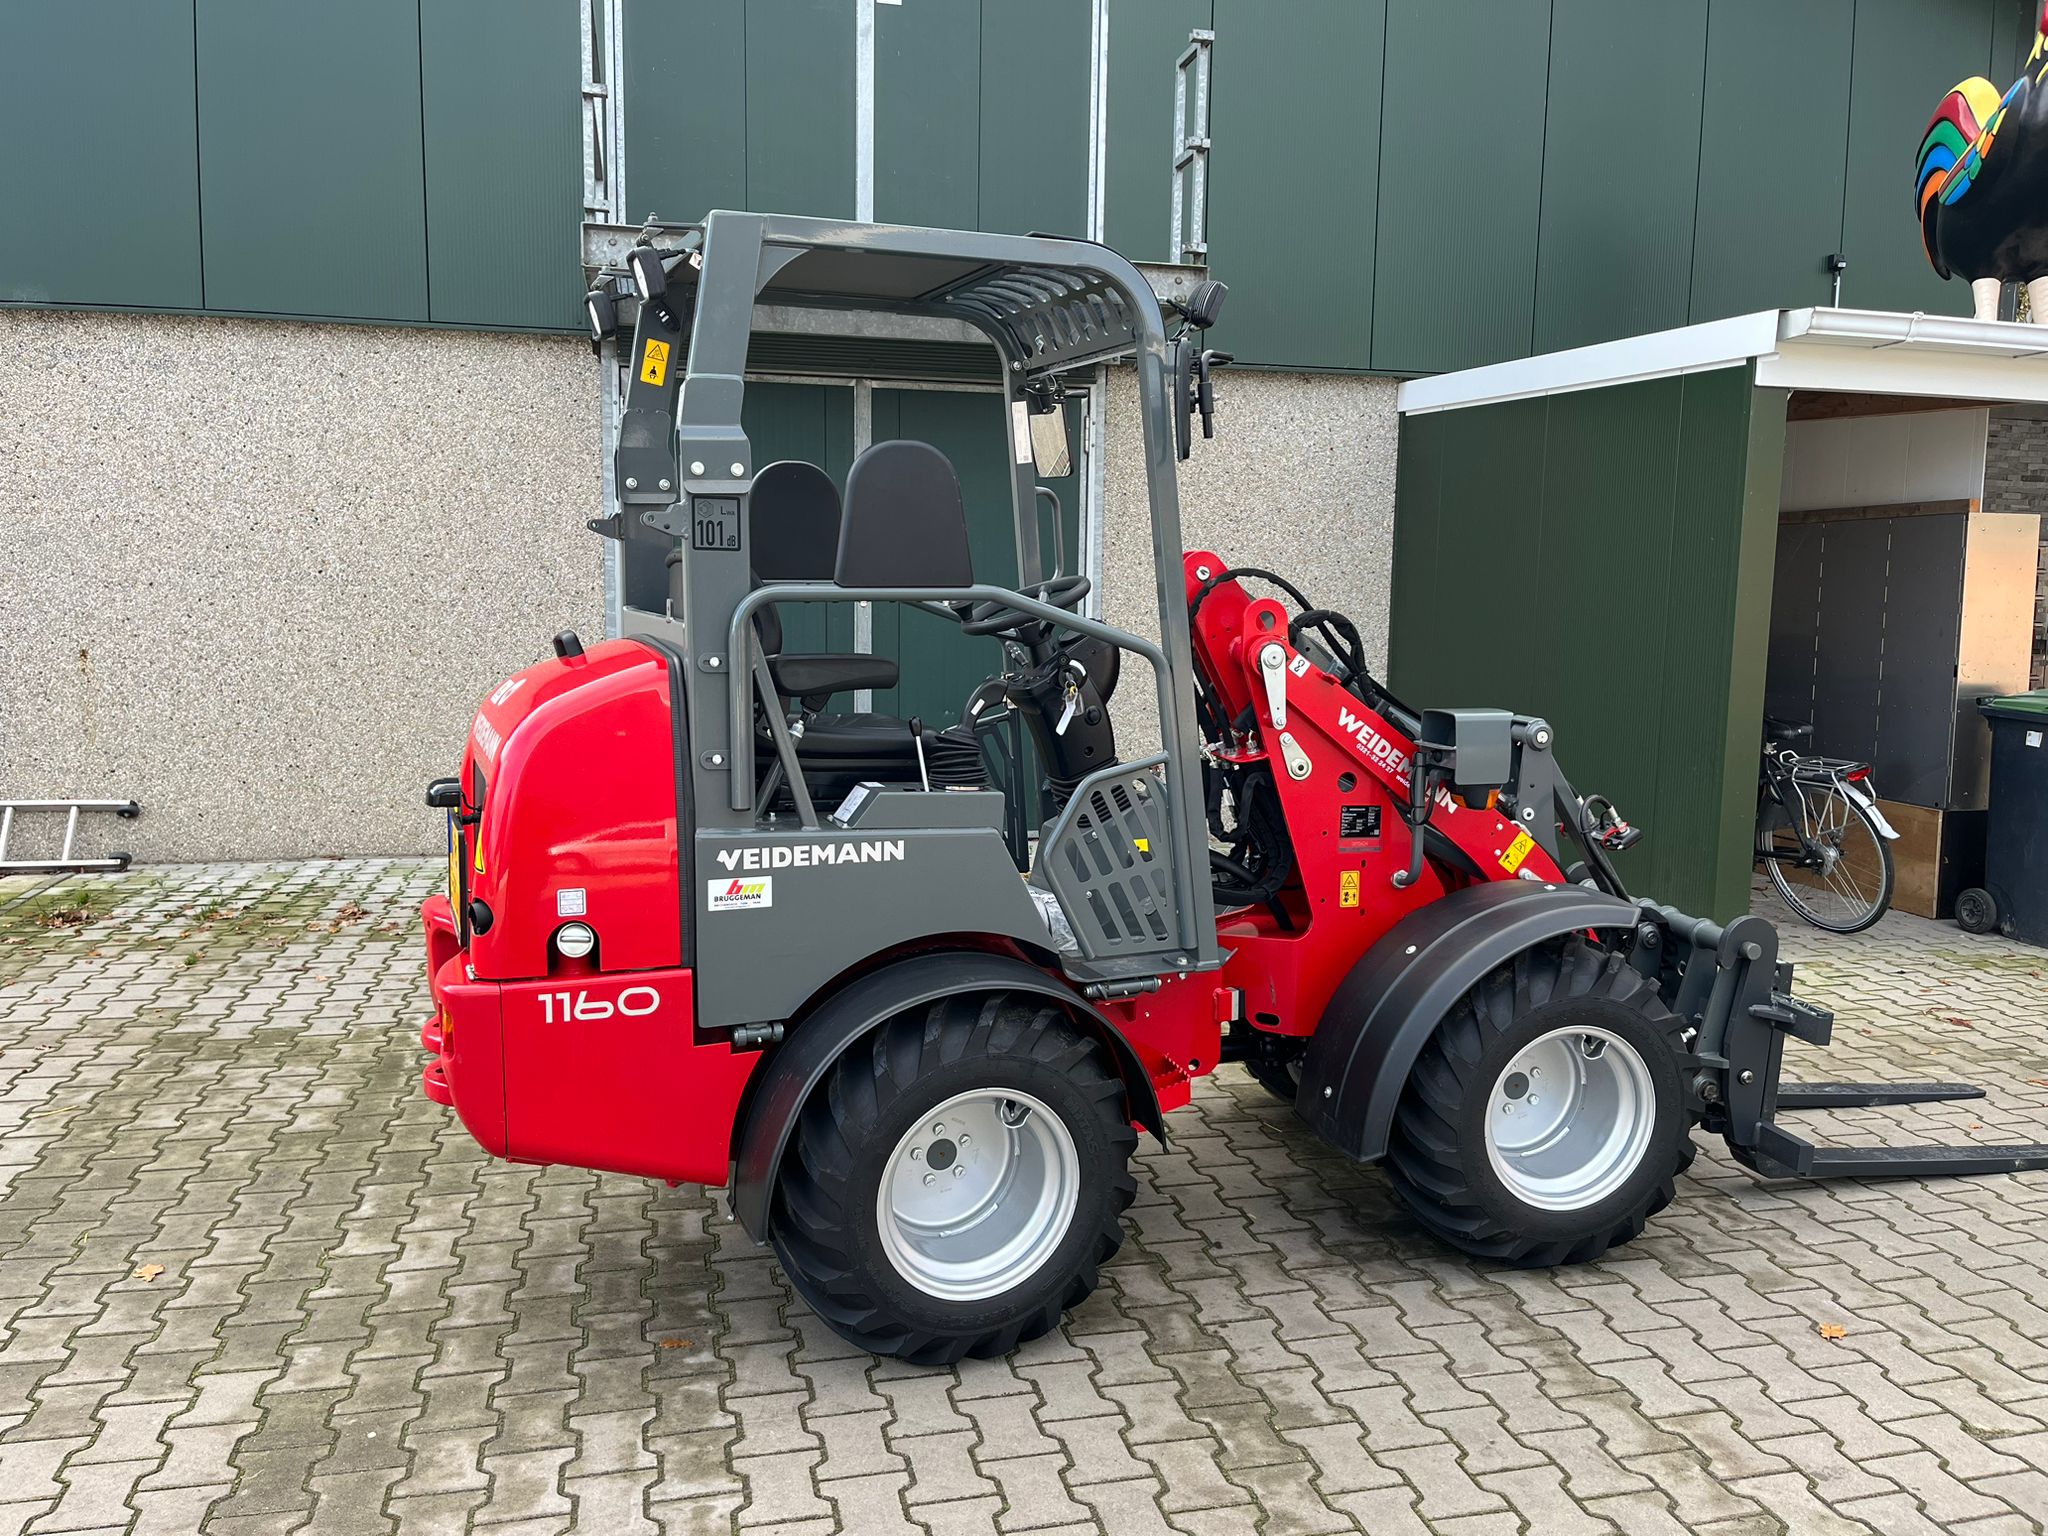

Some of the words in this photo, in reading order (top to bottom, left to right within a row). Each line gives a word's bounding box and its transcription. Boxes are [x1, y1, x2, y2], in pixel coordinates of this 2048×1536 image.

[696, 519, 723, 547] 101
[726, 534, 736, 547] dB
[713, 893, 762, 903] BRUGGEMAN
[537, 985, 660, 1024] 1160
